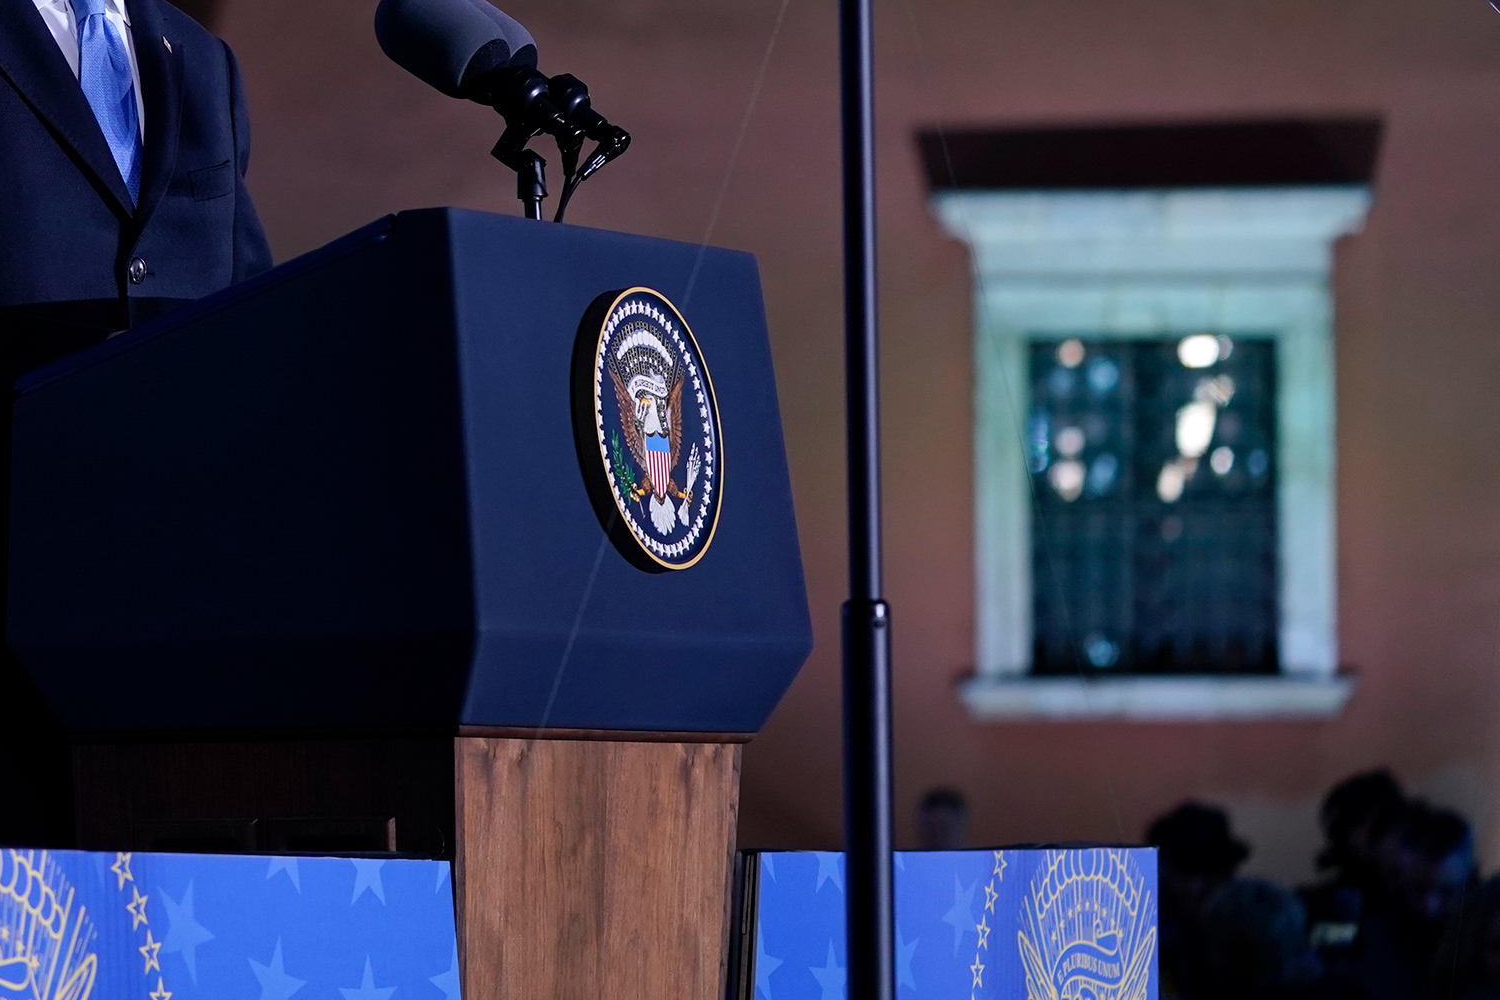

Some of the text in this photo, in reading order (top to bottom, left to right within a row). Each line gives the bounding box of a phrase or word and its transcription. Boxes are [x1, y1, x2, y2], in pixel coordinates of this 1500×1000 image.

[1057, 952, 1121, 986] E PLURIBUS UNUM
